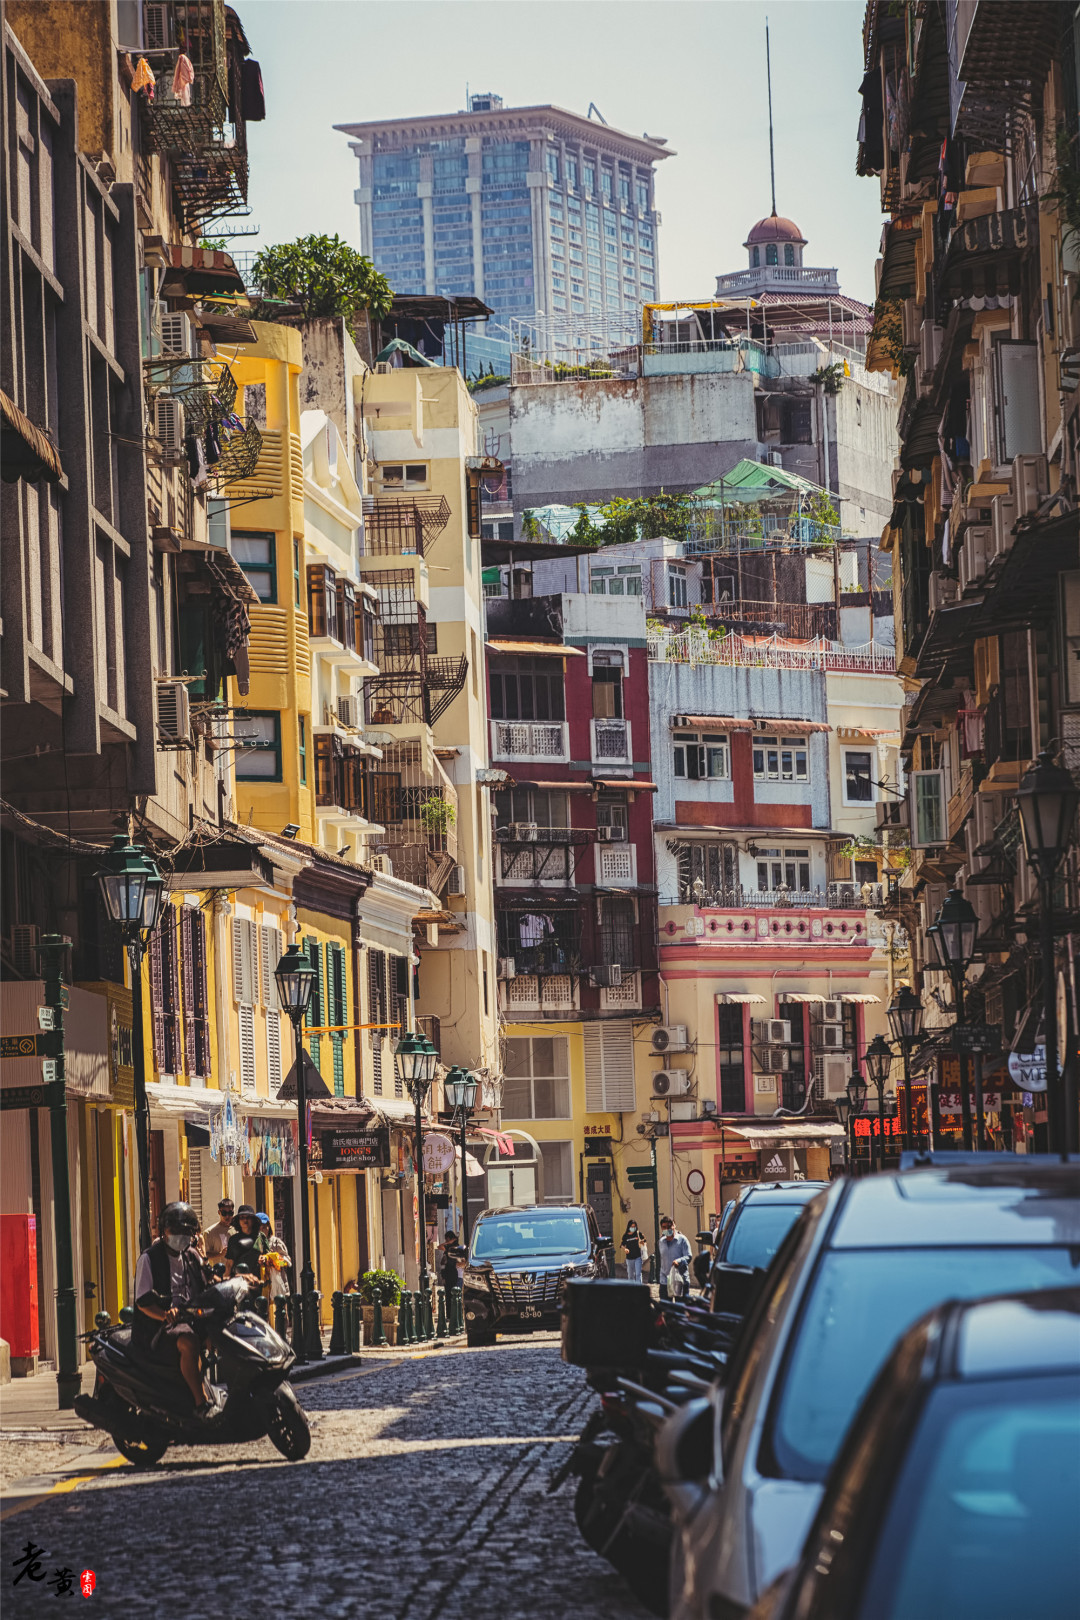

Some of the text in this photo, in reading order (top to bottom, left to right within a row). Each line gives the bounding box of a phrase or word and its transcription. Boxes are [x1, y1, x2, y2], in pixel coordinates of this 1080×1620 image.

[340, 1147, 371, 1155] IONG'S
[336, 1154, 376, 1162] magic shop
[764, 1166, 787, 1174] adidas
